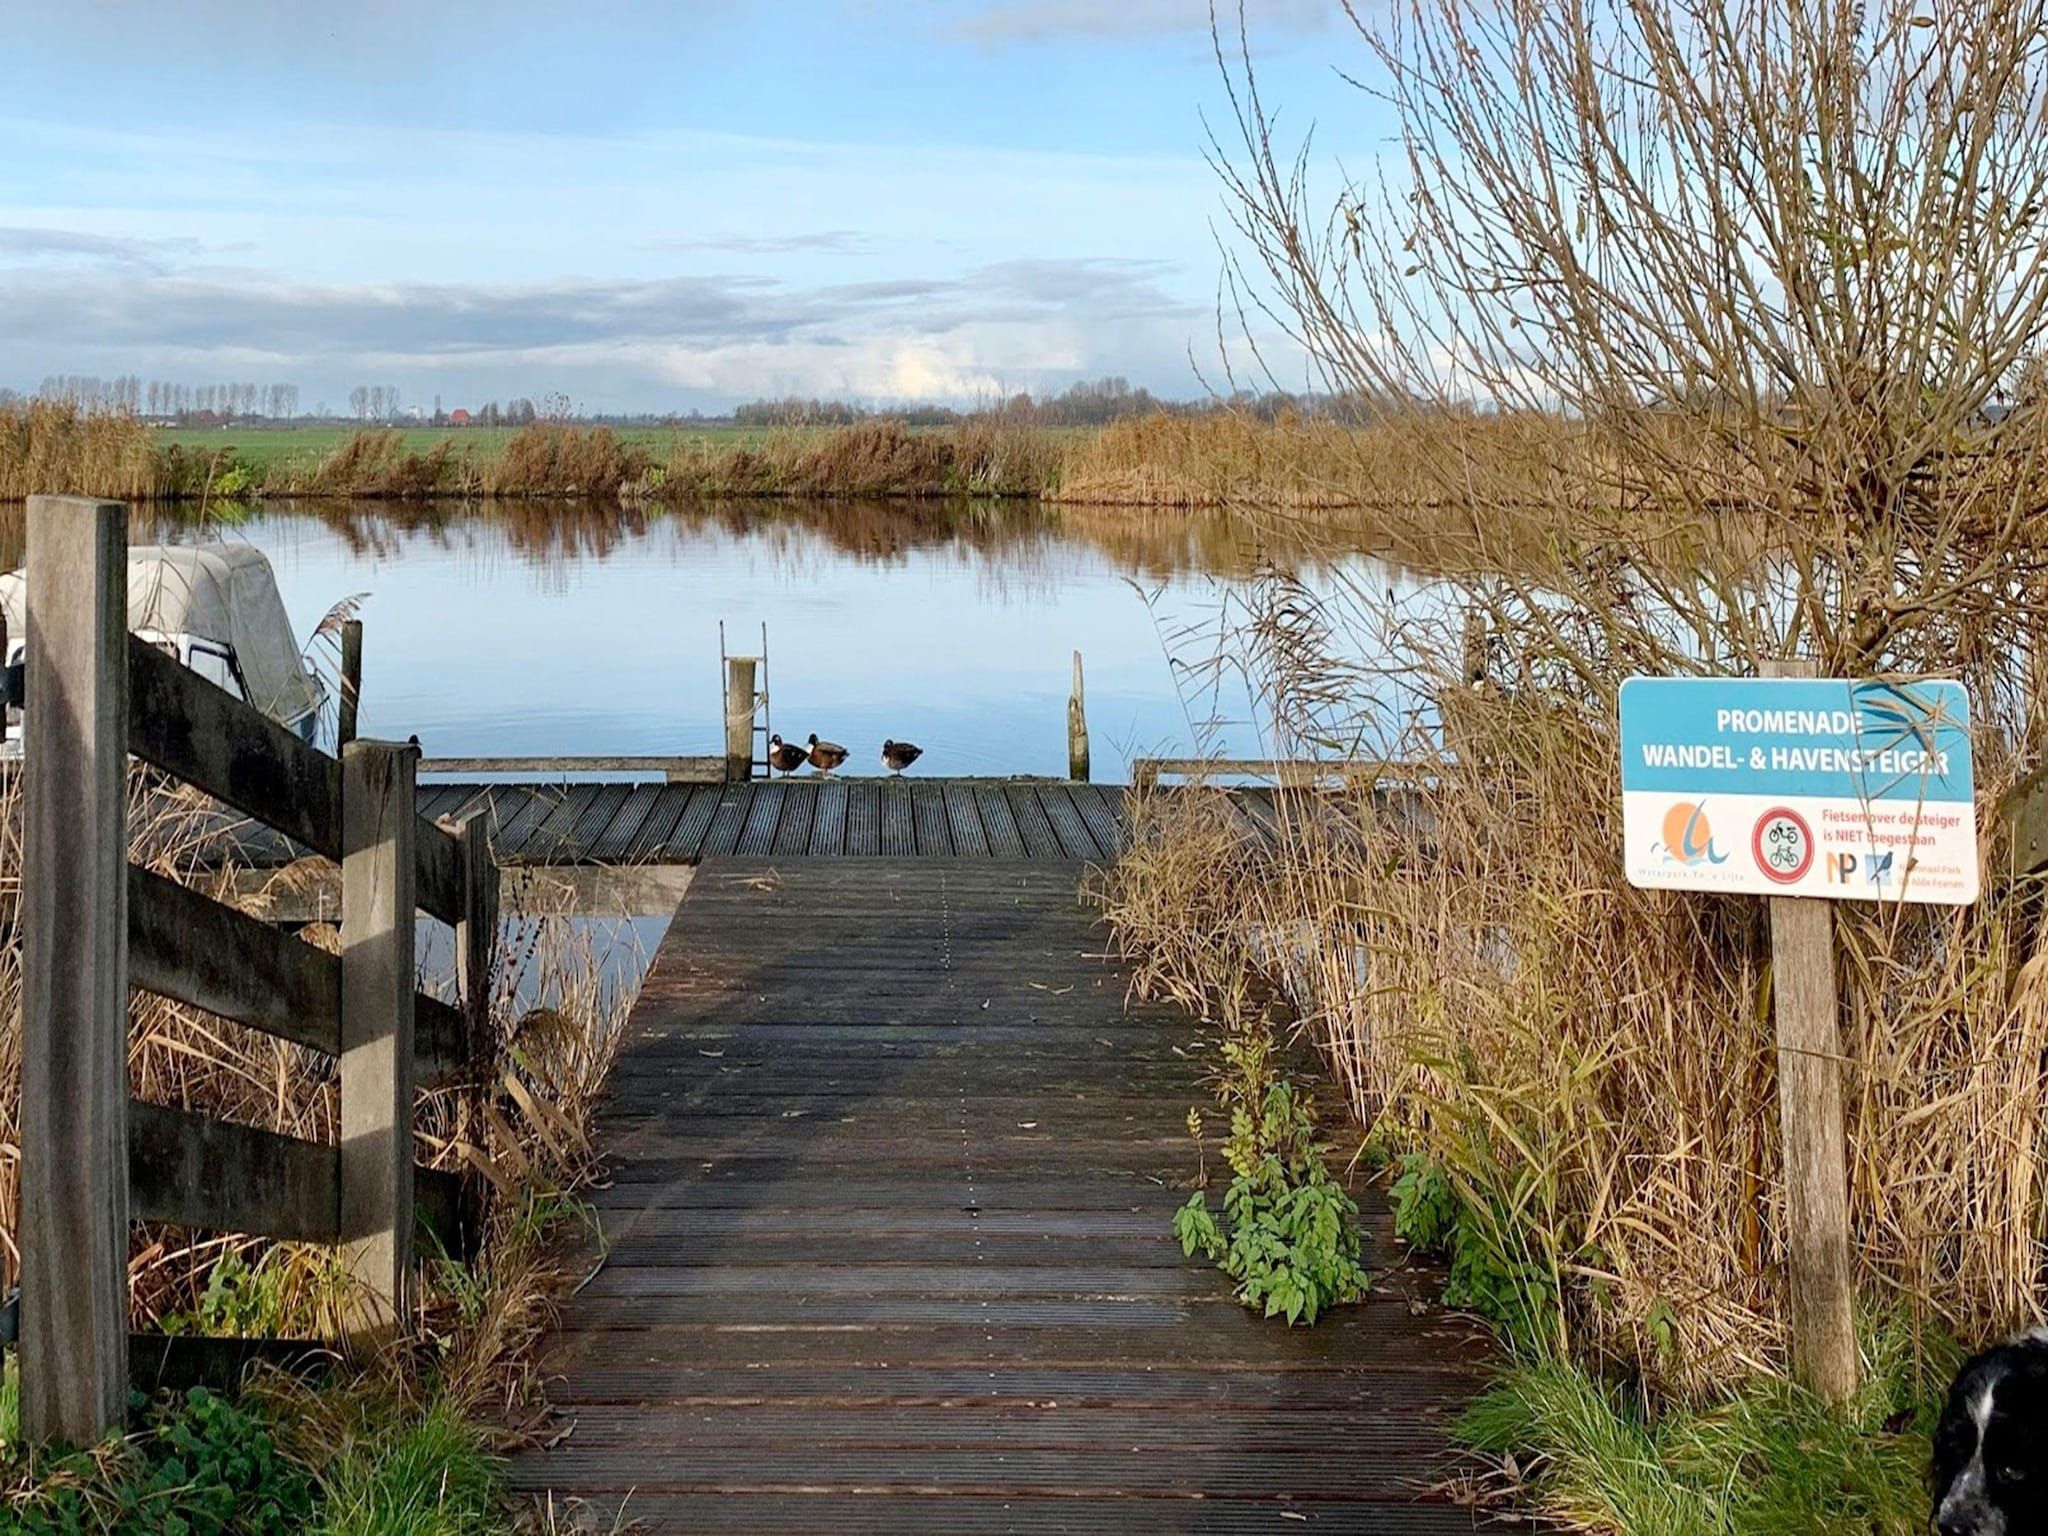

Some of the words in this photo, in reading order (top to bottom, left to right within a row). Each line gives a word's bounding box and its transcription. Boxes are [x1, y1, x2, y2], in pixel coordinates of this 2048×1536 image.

[1717, 709, 1863, 735] PROMENADE
[1642, 745, 1744, 769] WANDEL-
[1750, 746, 1766, 770] &
[1772, 747, 1950, 774] HAVENSTEIGER
[1822, 808, 1868, 822] Fietsen
[1870, 813, 1896, 824] over
[1899, 811, 1914, 824] de
[1915, 813, 1960, 829] steiger
[1823, 829, 1833, 841] is
[1836, 830, 1863, 842] NIET
